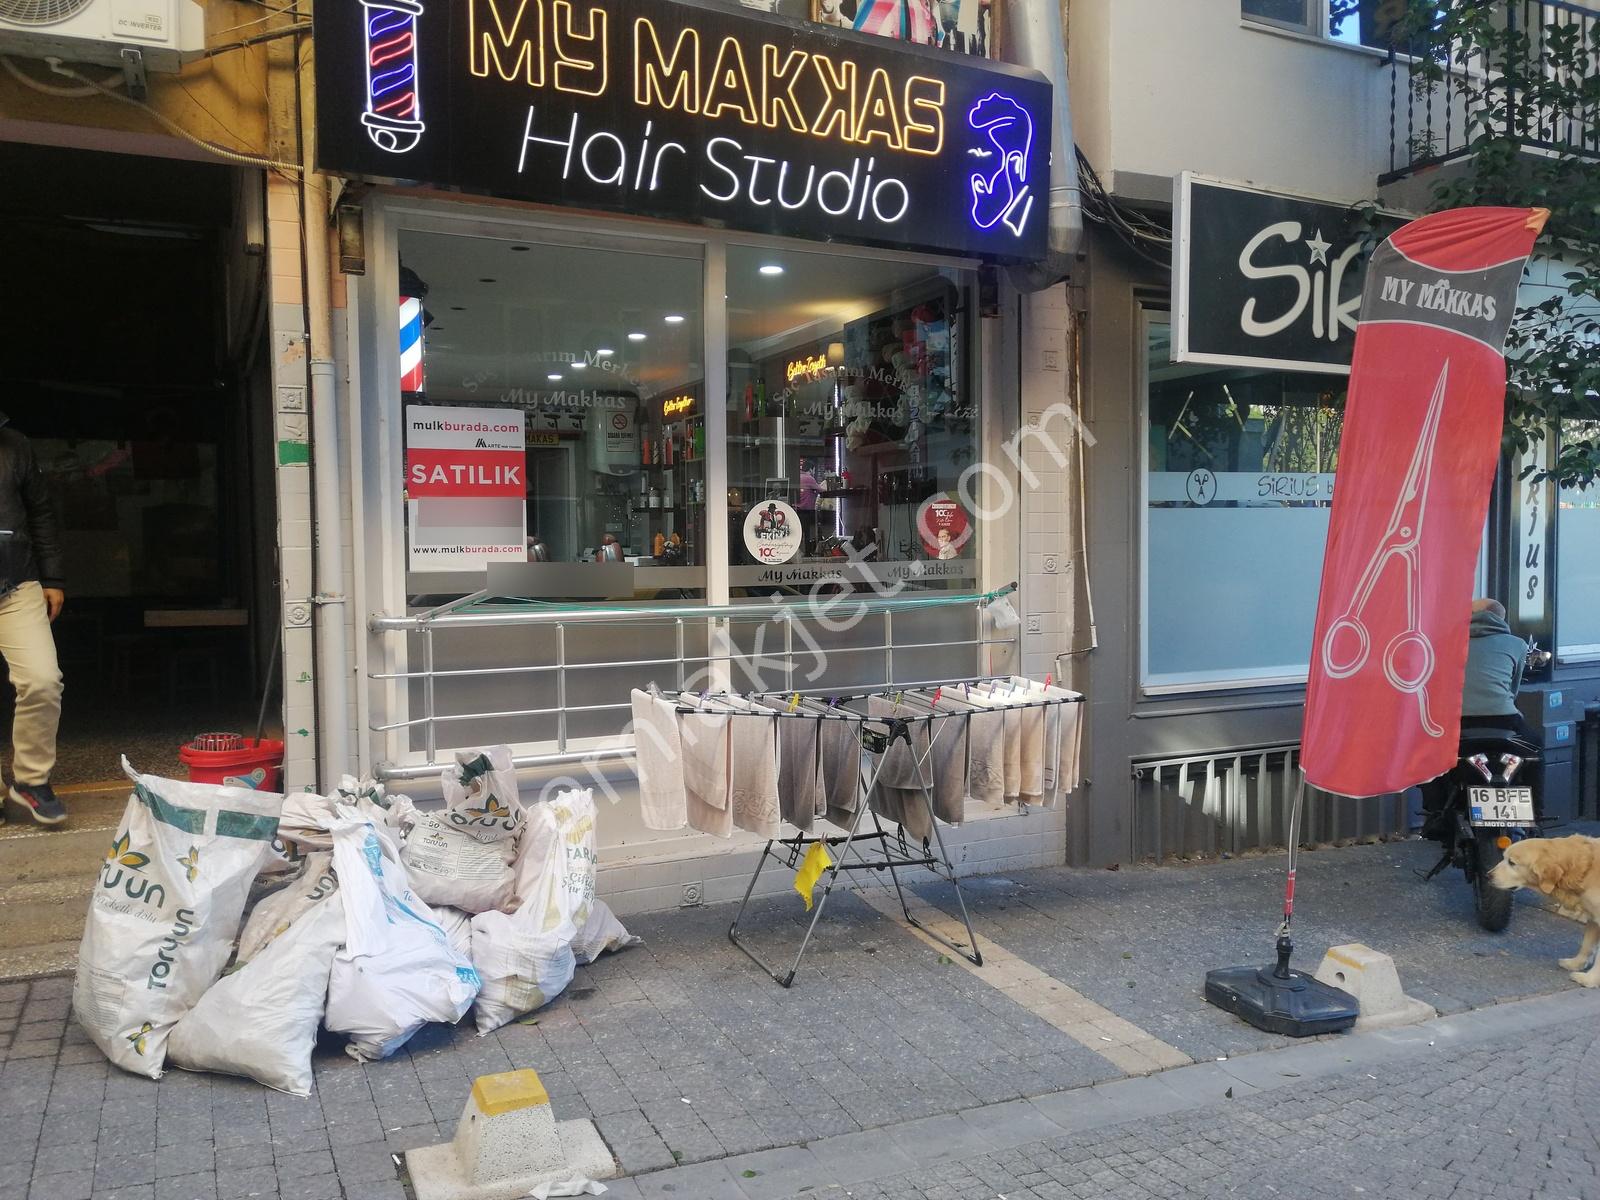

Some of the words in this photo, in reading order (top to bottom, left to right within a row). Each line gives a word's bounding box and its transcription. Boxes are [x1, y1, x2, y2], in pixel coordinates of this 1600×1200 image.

[130, 21, 162, 31] INVERTER
[468, 0, 608, 97] MY
[633, 17, 946, 155] MAKKAS
[517, 105, 687, 191] Hair
[699, 136, 910, 224] Studio
[1379, 275, 1416, 306] MY
[500, 388, 539, 410] My
[543, 390, 627, 409] Makkas
[413, 421, 520, 433] mulkburada.com
[411, 464, 521, 485] SATILIK
[413, 545, 523, 554] www.mulkburada.com
[758, 568, 783, 583] My
[1472, 789, 1490, 802] 16
[1495, 789, 1531, 803] BFE
[1493, 805, 1518, 819] 141
